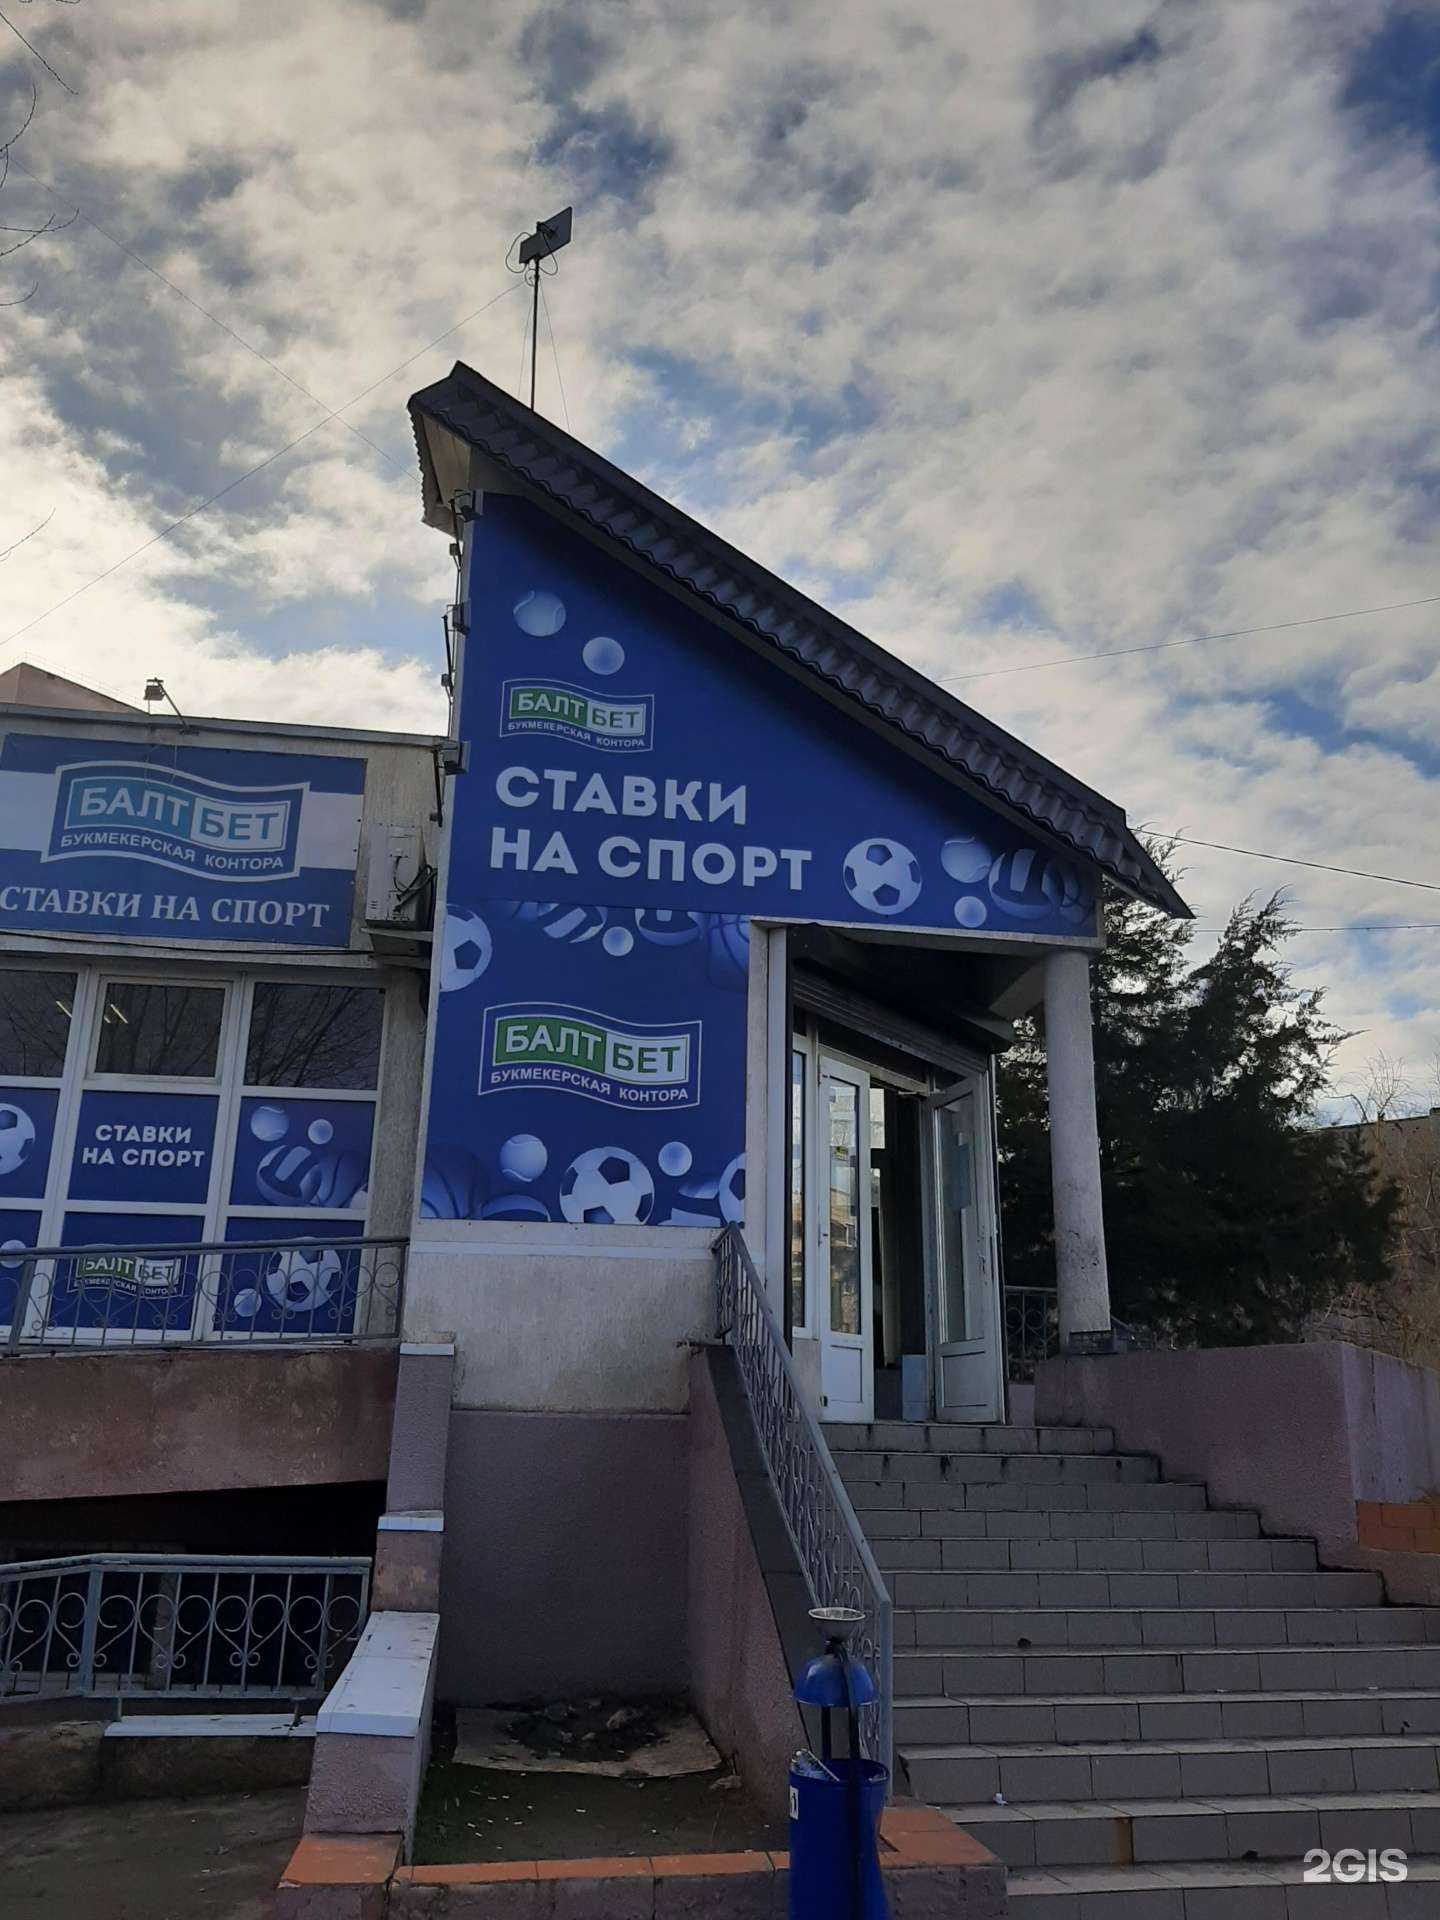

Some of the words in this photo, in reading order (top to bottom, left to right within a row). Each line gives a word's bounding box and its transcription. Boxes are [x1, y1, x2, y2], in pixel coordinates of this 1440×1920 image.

[508, 719, 591, 742] БУКМЕКЕРСКАЯ
[596, 736, 645, 748] КОНТОРА
[495, 766, 748, 826] СТАВКИ
[60, 831, 196, 863] БУКМЕКЕРСКАЯ
[204, 853, 285, 870] КОНТОРА
[490, 826, 579, 876] НА
[598, 835, 812, 891] СПОРТ
[0, 886, 143, 919] СТАВКИ
[152, 892, 201, 922] НА
[211, 898, 331, 929] СПОРТ
[490, 1067, 612, 1096] БУКМЕКЕРСКАЯ
[619, 1087, 689, 1103] КОНТОРА
[95, 1124, 192, 1144] СТАВКИ
[82, 1147, 115, 1165] НА
[122, 1148, 206, 1168] СПОРТ
